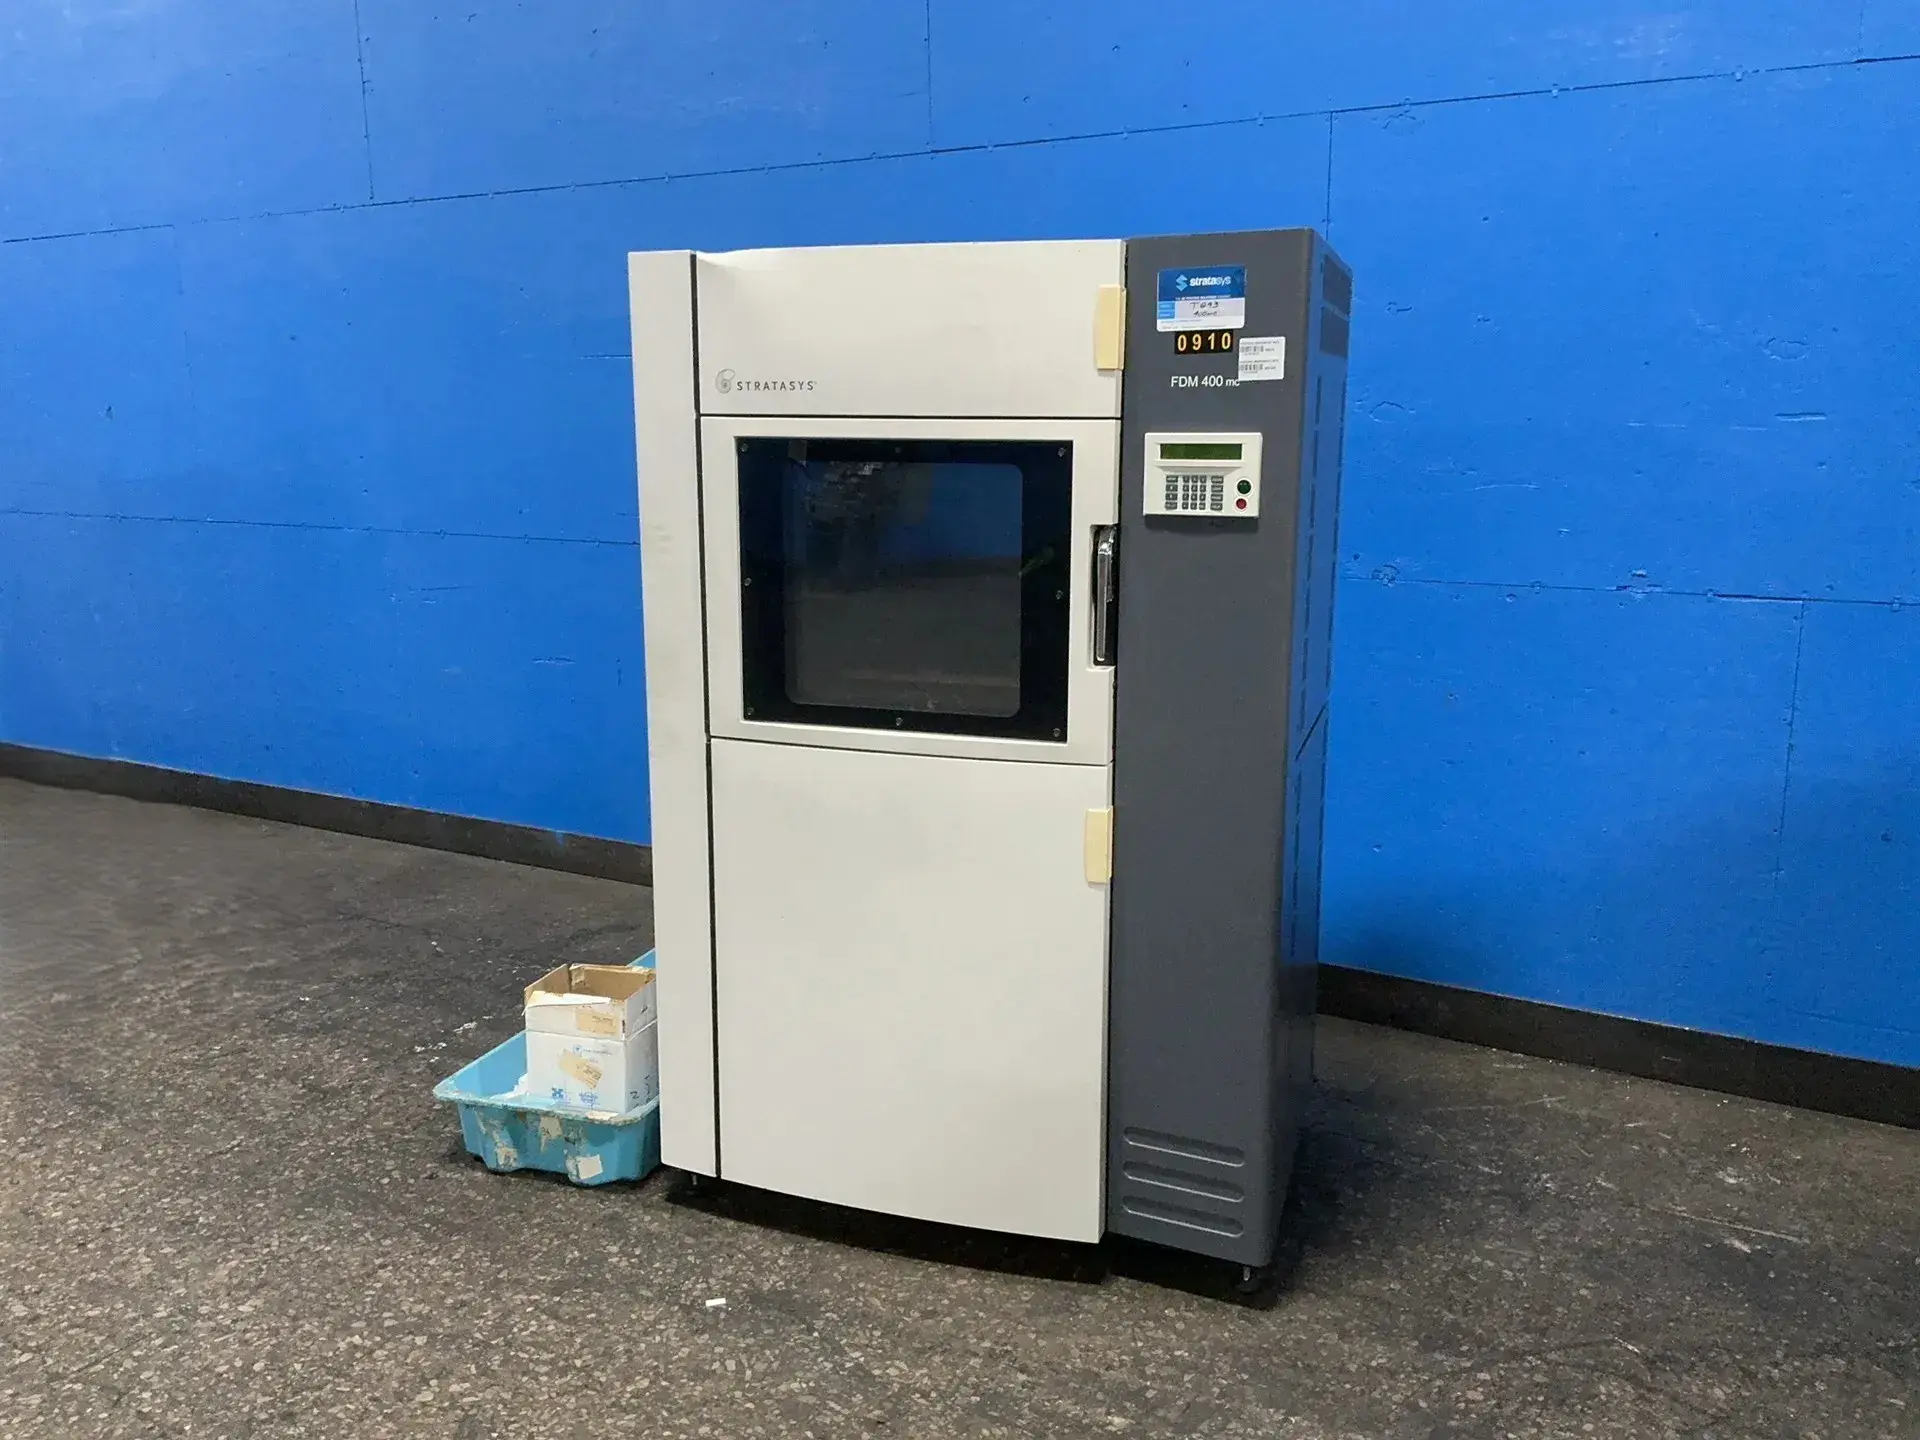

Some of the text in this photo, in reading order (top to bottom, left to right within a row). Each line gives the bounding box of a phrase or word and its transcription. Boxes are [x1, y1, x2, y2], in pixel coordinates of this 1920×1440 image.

[1190, 276, 1232, 287] stratasys
[1177, 332, 1232, 352] 0910
[736, 380, 814, 391] STRATASYS
[1170, 375, 1199, 388] FDM
[1201, 374, 1224, 387] 400
